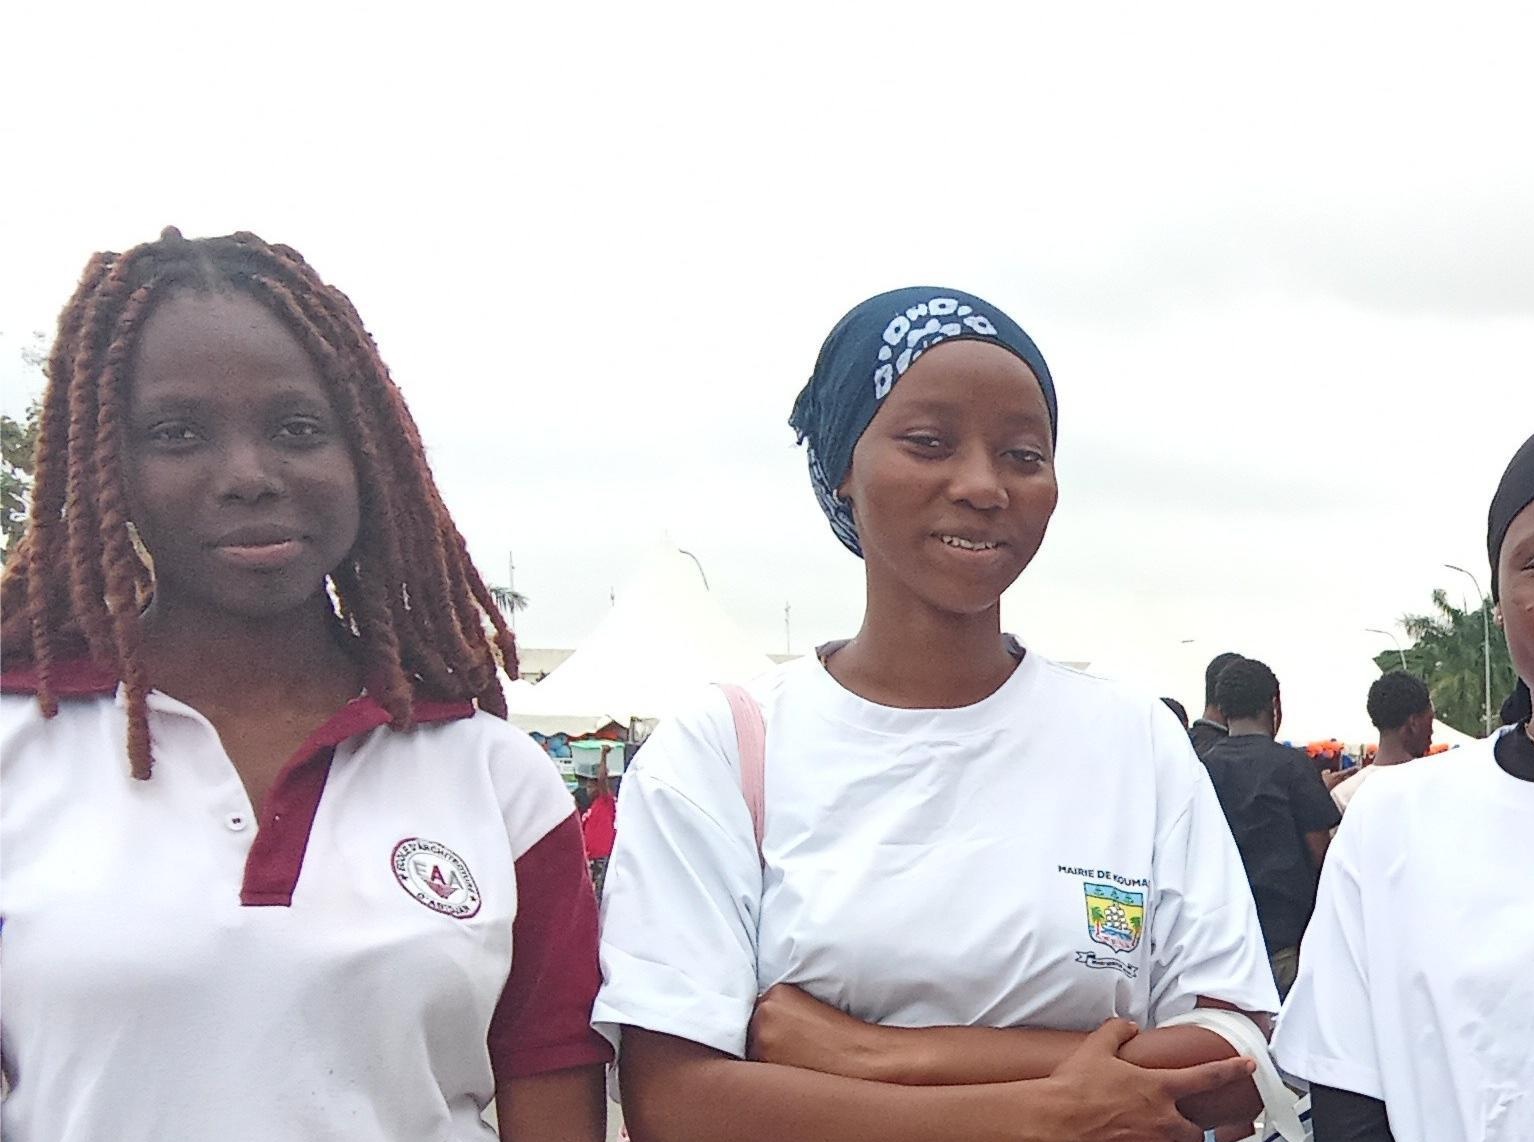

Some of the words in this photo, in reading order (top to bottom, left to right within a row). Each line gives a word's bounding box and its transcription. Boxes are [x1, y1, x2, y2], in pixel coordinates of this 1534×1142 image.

[1058, 865, 1095, 879] MAIRIE
[1097, 870, 1112, 880] DE
[1113, 874, 1150, 888] KOUMA
